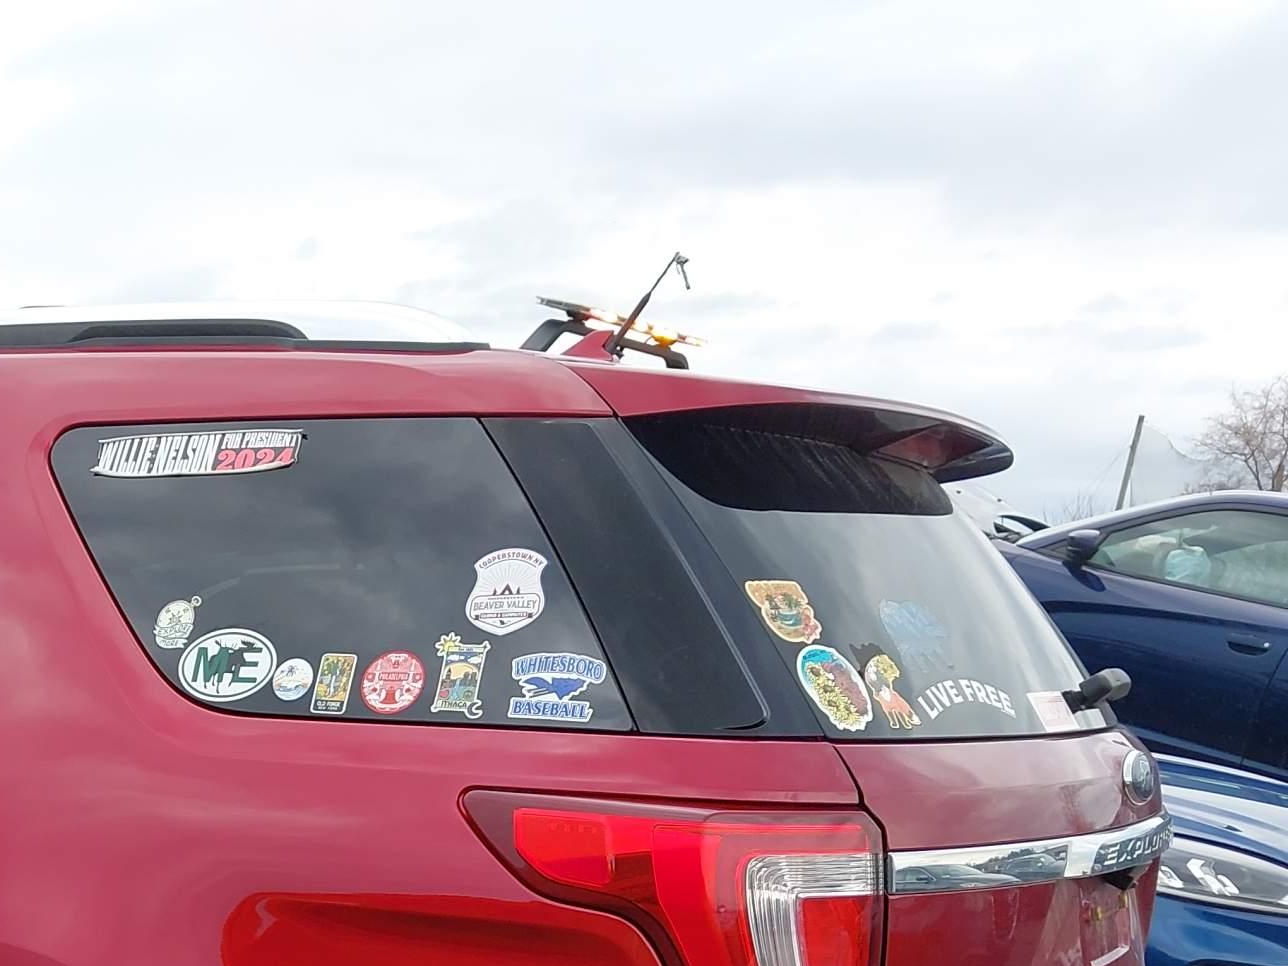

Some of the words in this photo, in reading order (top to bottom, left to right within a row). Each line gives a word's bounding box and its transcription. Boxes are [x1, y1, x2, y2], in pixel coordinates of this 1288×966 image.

[221, 433, 243, 449] FOR
[241, 432, 297, 448] PRESIDENT
[98, 437, 158, 474] WILLIE
[150, 434, 223, 474] NELSON
[216, 448, 294, 470] 2024
[478, 551, 534, 569] COOPERSTOWN
[533, 557, 544, 566] NY
[473, 601, 504, 611] BEAVER
[505, 599, 537, 609] VALLEY
[192, 647, 263, 683] ME
[515, 655, 602, 680] WHITESBORO
[512, 700, 589, 719] BASEBALL
[917, 680, 965, 720] LIVE
[958, 679, 1016, 717] FREE
